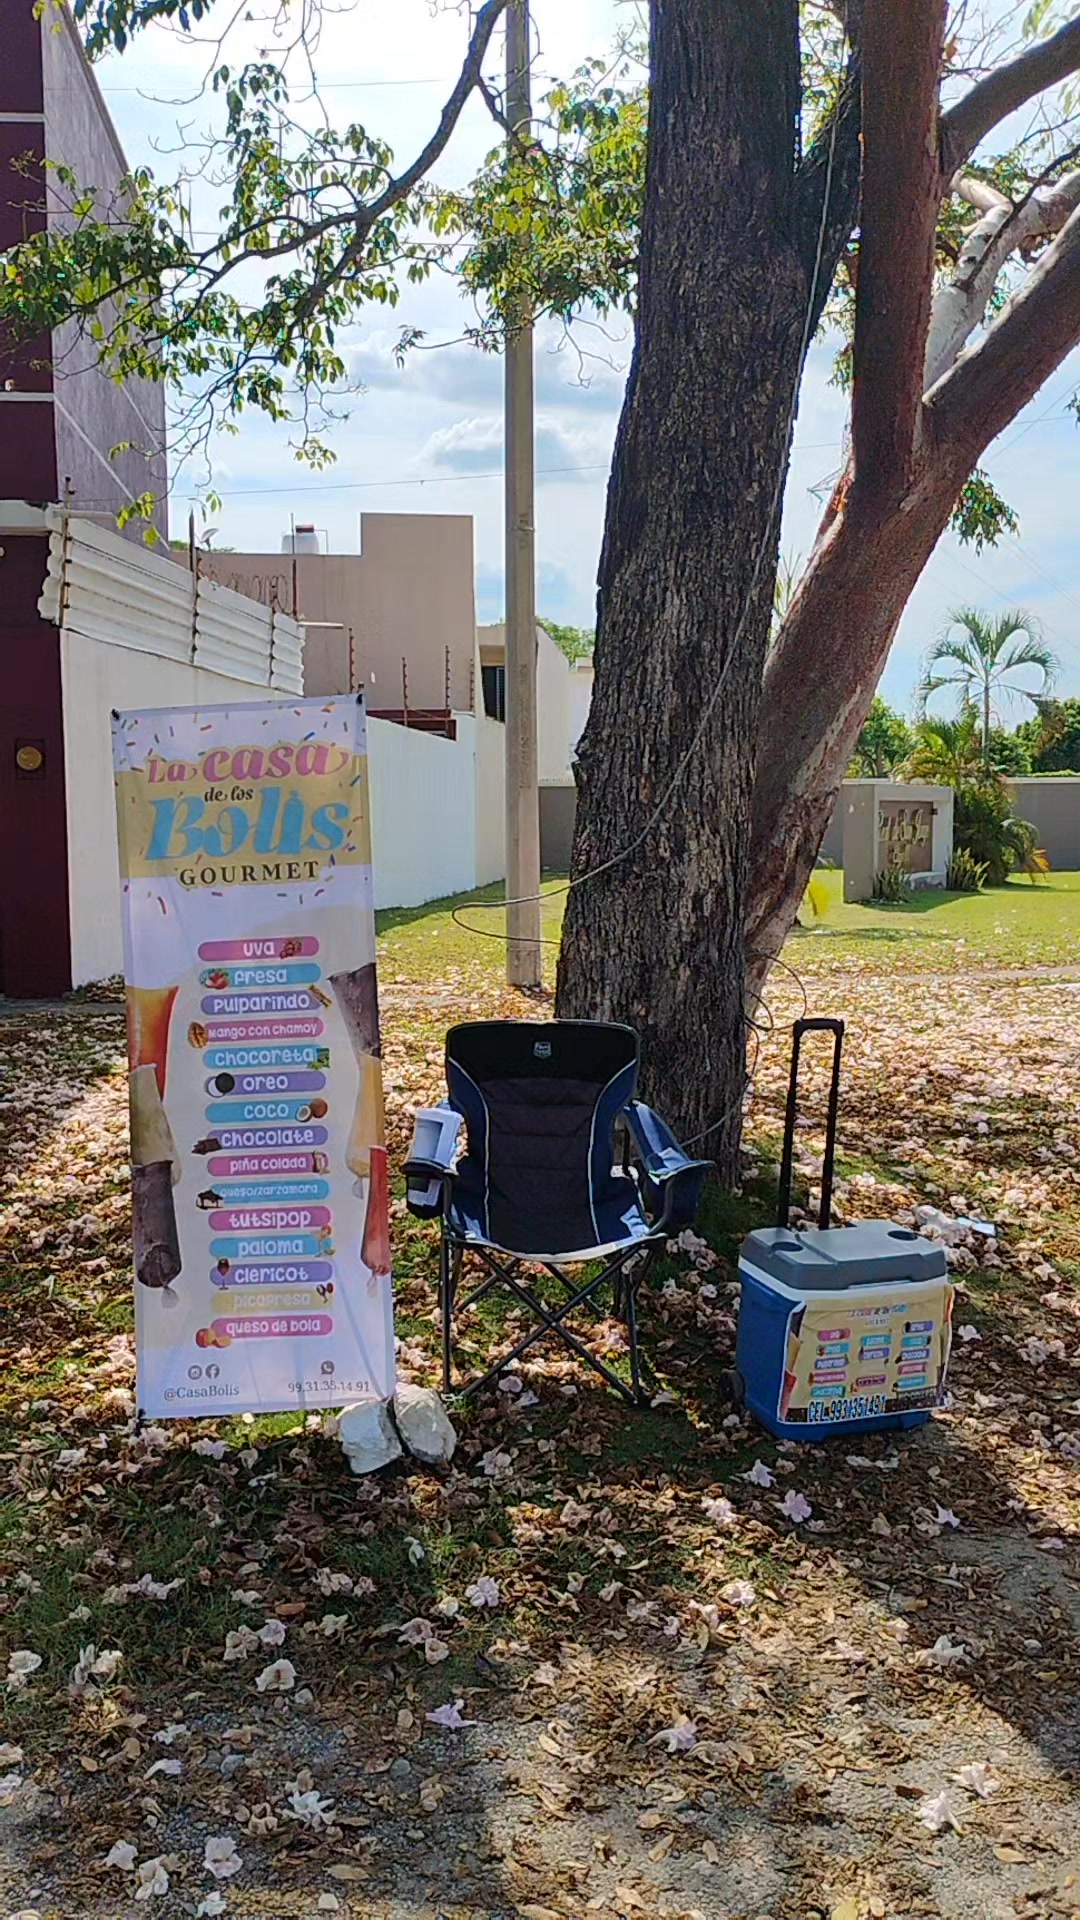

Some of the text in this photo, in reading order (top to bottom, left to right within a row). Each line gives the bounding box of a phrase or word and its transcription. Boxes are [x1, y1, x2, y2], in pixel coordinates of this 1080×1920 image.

[204, 785, 254, 802] de los
[144, 786, 350, 861] Bolis
[179, 861, 321, 886] GOURMET
[234, 968, 288, 985] fresa
[248, 1025, 271, 1036] con
[242, 1075, 289, 1091] oreo
[243, 1103, 289, 1118] coco
[221, 1129, 314, 1147] chocolate
[261, 1156, 307, 1170] colada
[229, 1210, 312, 1229] tutsipop
[237, 1239, 304, 1258] paloma
[234, 1266, 309, 1283] clericot
[226, 1319, 321, 1337] queso de bola
[163, 1383, 240, 1401] @CasaBolis
